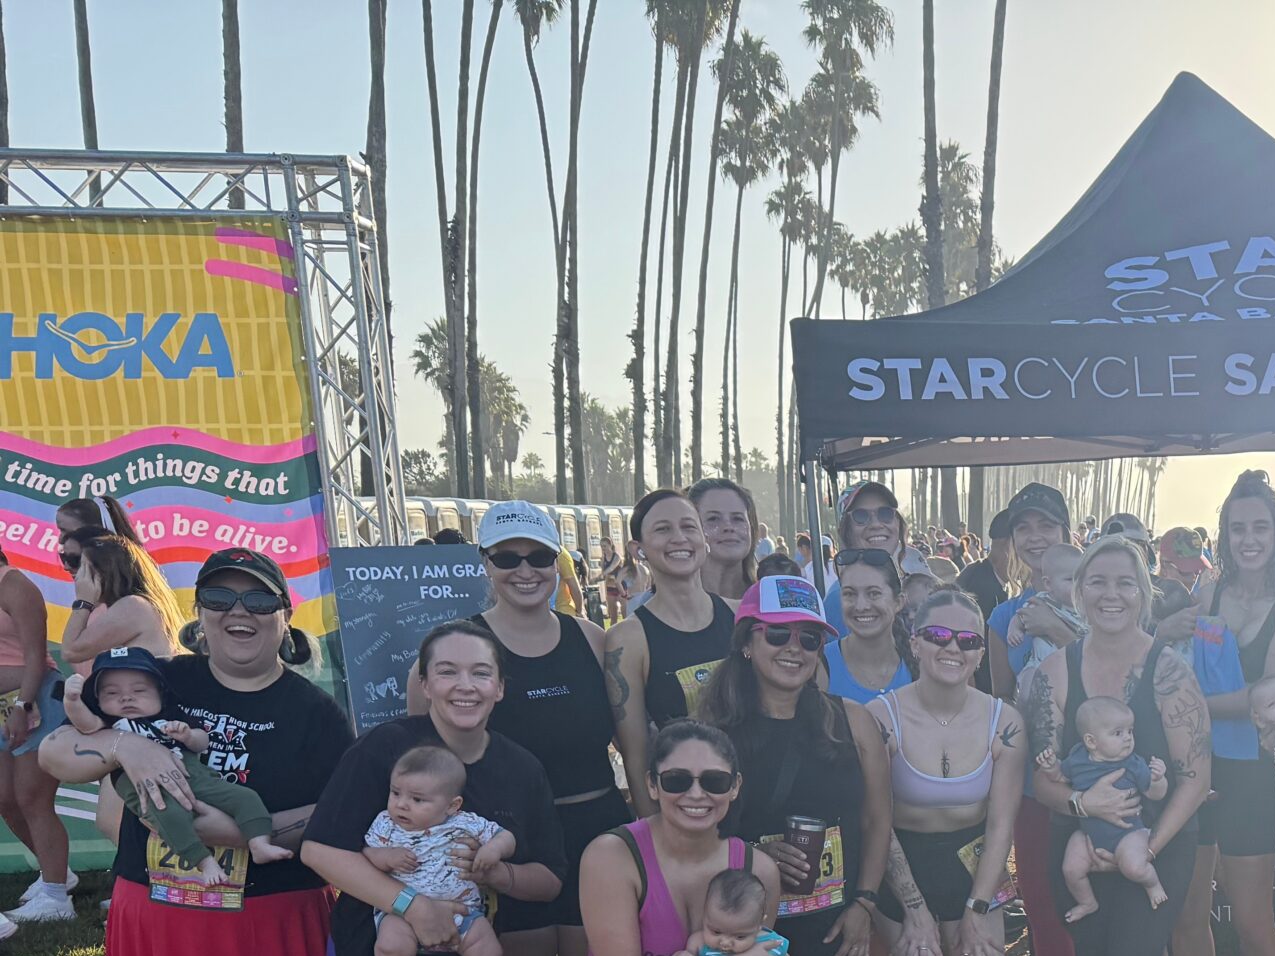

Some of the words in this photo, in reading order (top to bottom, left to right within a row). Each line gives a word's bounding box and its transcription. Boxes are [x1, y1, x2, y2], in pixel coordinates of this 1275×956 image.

[0, 312, 235, 380] HOKA
[847, 354, 1200, 401] STARCYCLE
[5, 461, 72, 497] time
[79, 473, 122, 499] for
[125, 454, 221, 485] things
[224, 467, 290, 496] that
[137, 519, 165, 544] to
[173, 513, 207, 538] be
[214, 523, 298, 553] alive.
[346, 566, 409, 582] TODAY,
[412, 566, 418, 579] I
[422, 564, 449, 579] AM
[453, 564, 488, 578] GRA
[419, 585, 470, 600] FOR...
[228, 716, 248, 729] HIGH
[249, 721, 275, 732] SCHOOL
[207, 752, 250, 771] EM
[158, 840, 235, 876] 24
